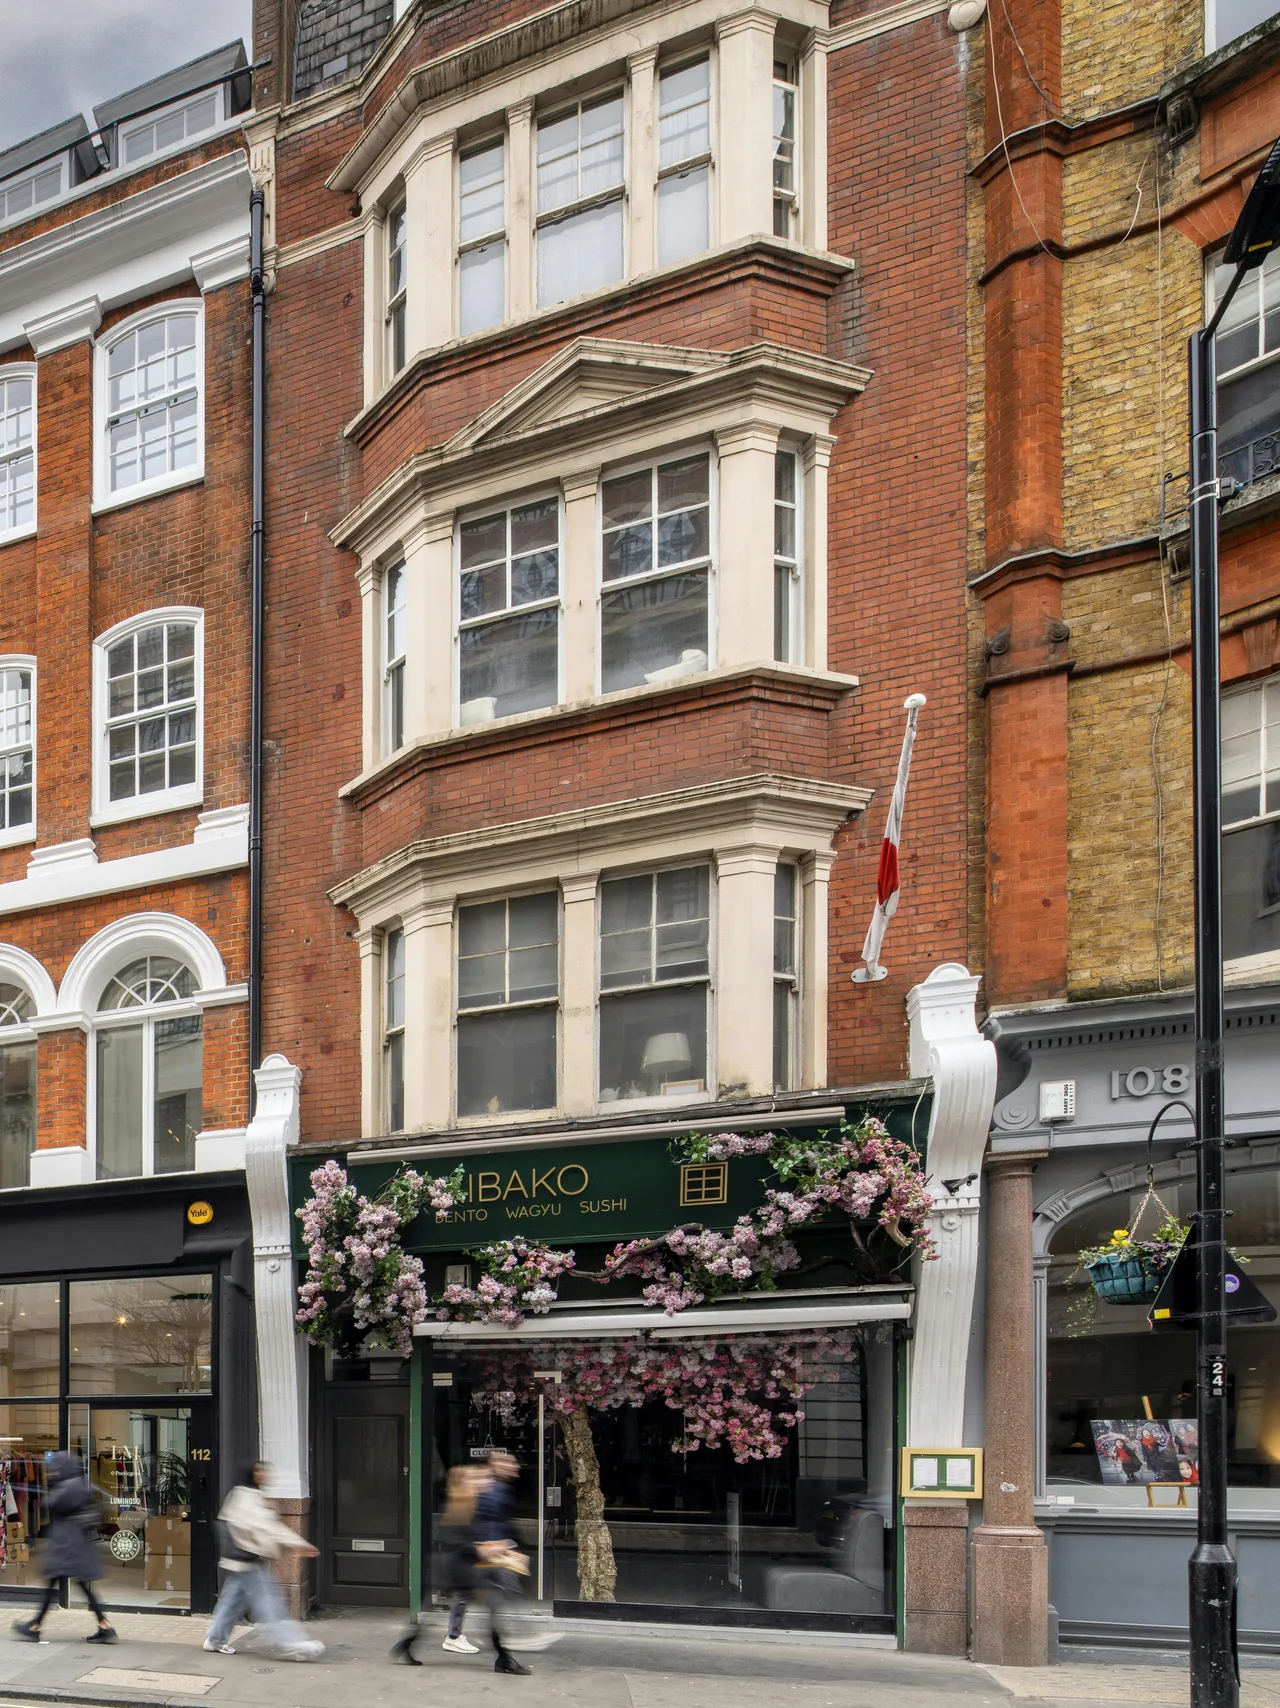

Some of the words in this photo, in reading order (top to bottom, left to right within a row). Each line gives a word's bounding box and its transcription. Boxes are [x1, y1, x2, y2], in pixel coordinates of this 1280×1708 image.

[1111, 1064, 1190, 1099] 108
[462, 1164, 589, 1203] IBAKO
[190, 1209, 208, 1218] Yale
[435, 1209, 488, 1224] BENTO
[505, 1203, 561, 1219] WAGYU
[579, 1198, 627, 1213] SUSHI
[191, 1448, 211, 1461] 112
[113, 1532, 137, 1543] POETIC
[113, 1547, 137, 1558] BRANDS
